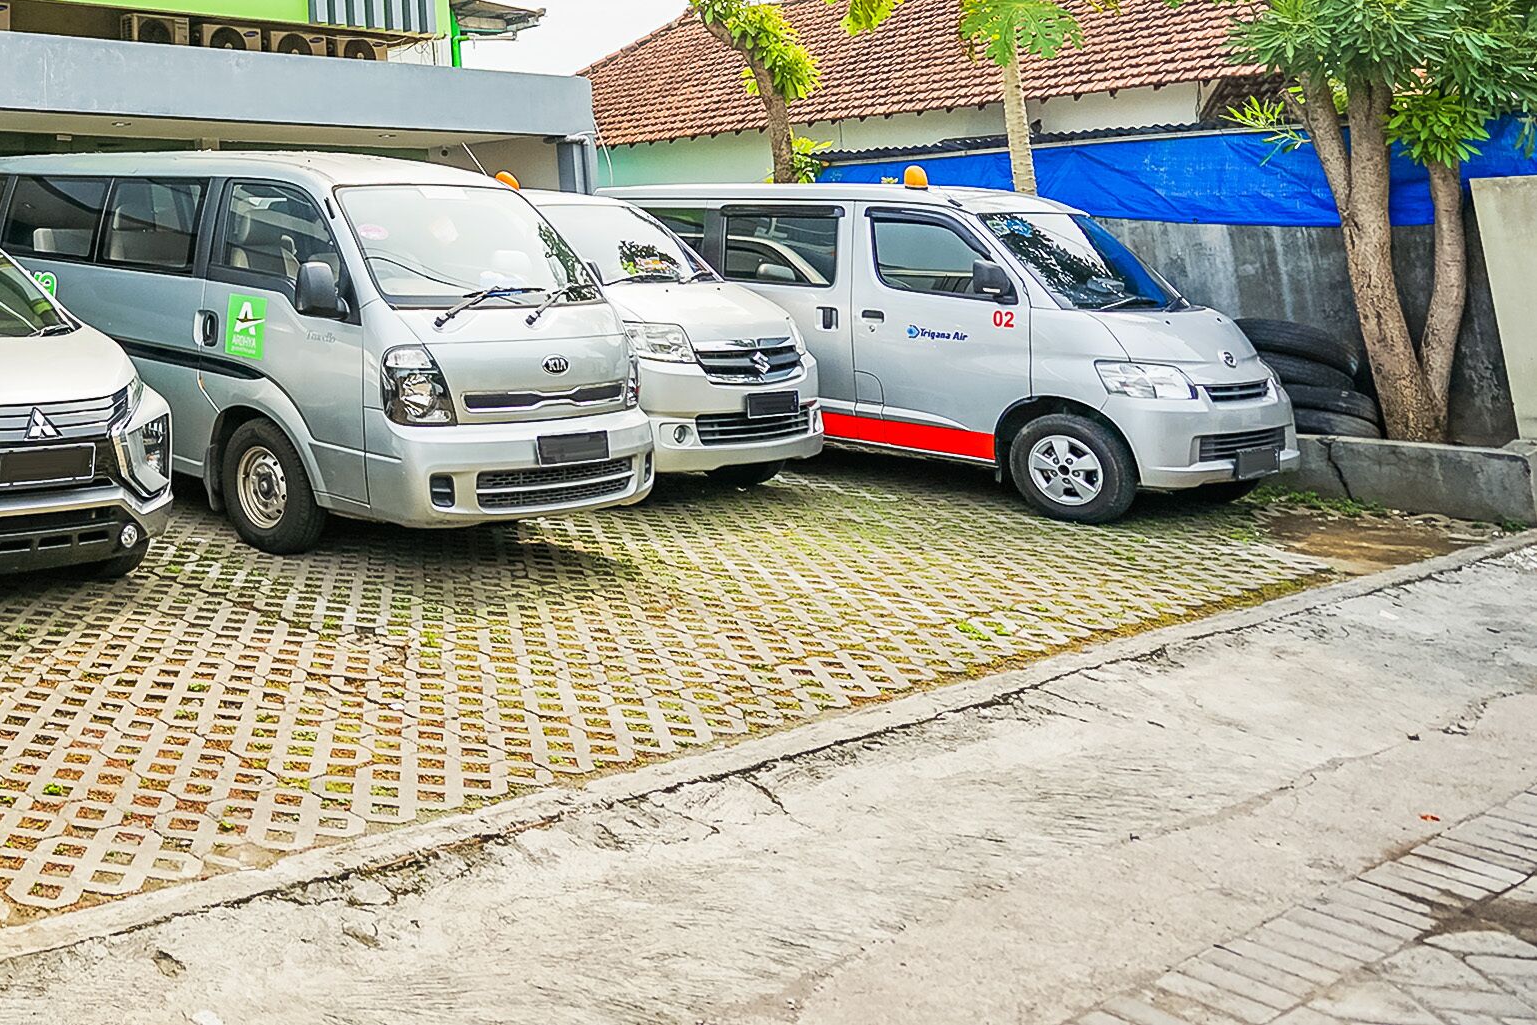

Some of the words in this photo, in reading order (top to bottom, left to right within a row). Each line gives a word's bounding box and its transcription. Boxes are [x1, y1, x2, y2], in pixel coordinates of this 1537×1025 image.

[993, 310, 1014, 328] 02
[920, 328, 951, 340] Trigana
[952, 331, 968, 341] Air
[548, 358, 567, 371] KIA
